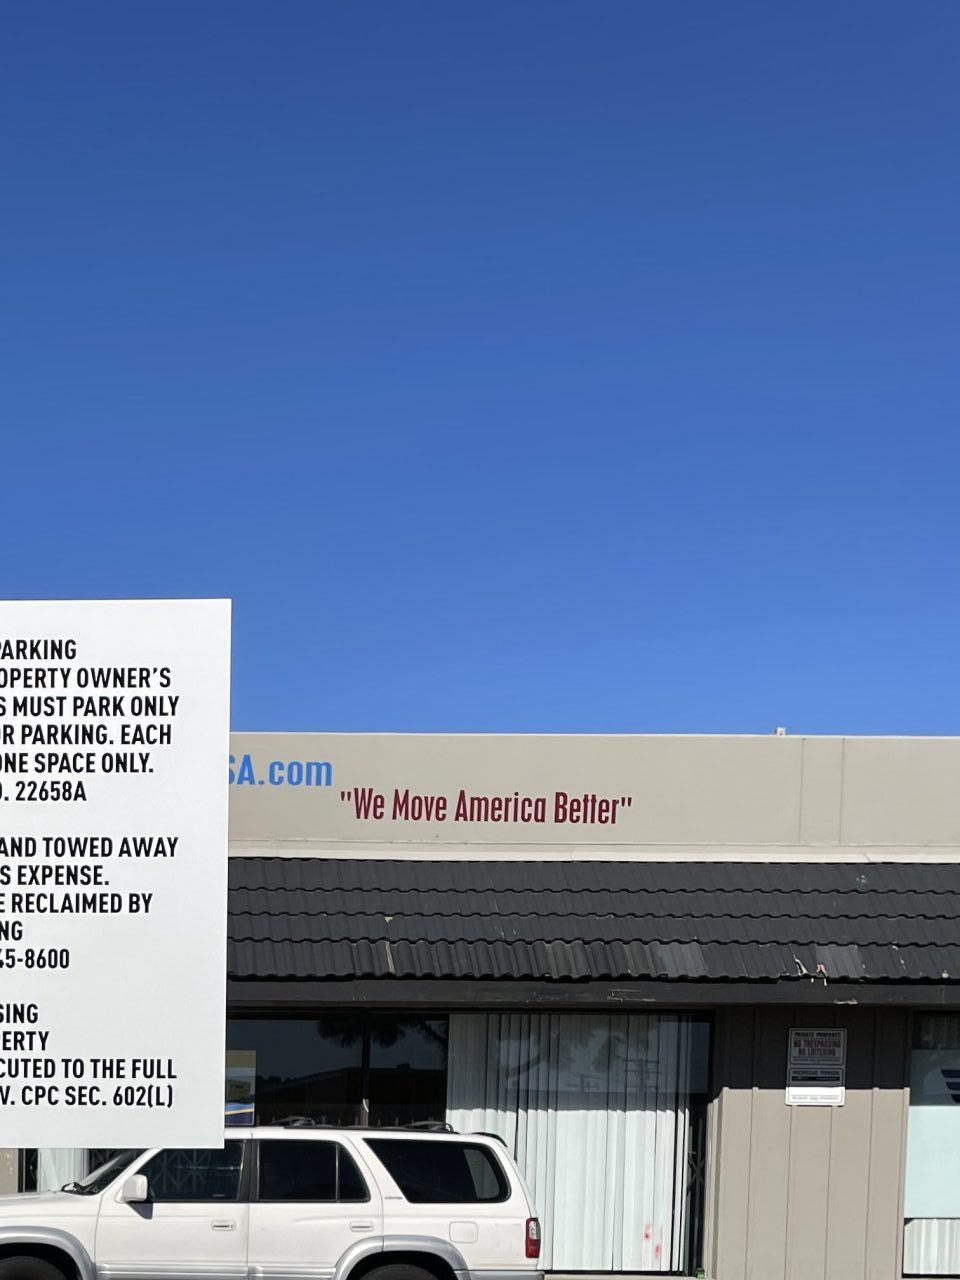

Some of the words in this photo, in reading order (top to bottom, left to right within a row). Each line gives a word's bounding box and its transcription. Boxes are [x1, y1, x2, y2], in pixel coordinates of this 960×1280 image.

[12, 695, 67, 717] MUST
[72, 695, 126, 717] PARK
[130, 695, 180, 717] ONLY
[21, 723, 114, 745] PARKING.
[120, 723, 172, 745] EACH
[34, 752, 96, 774] SPACE
[101, 752, 154, 774] ONLY.
[15, 780, 87, 802] 22658A
[340, 788, 385, 820] "We
[392, 788, 447, 821] Move
[454, 790, 546, 823] America
[554, 792, 633, 825] Better"
[42, 836, 113, 858] TOWED
[118, 836, 179, 858] AWAY
[17, 864, 110, 886] EXPENSE.
[11, 892, 123, 914] RECLAIMED
[128, 892, 153, 914] BY
[60, 1058, 85, 1079] TO
[89, 1058, 126, 1079] THE
[131, 1058, 178, 1079] FULL
[21, 1085, 60, 1106] CPC
[64, 1085, 107, 1106] SEC.
[112, 1084, 173, 1109] 602(L)
